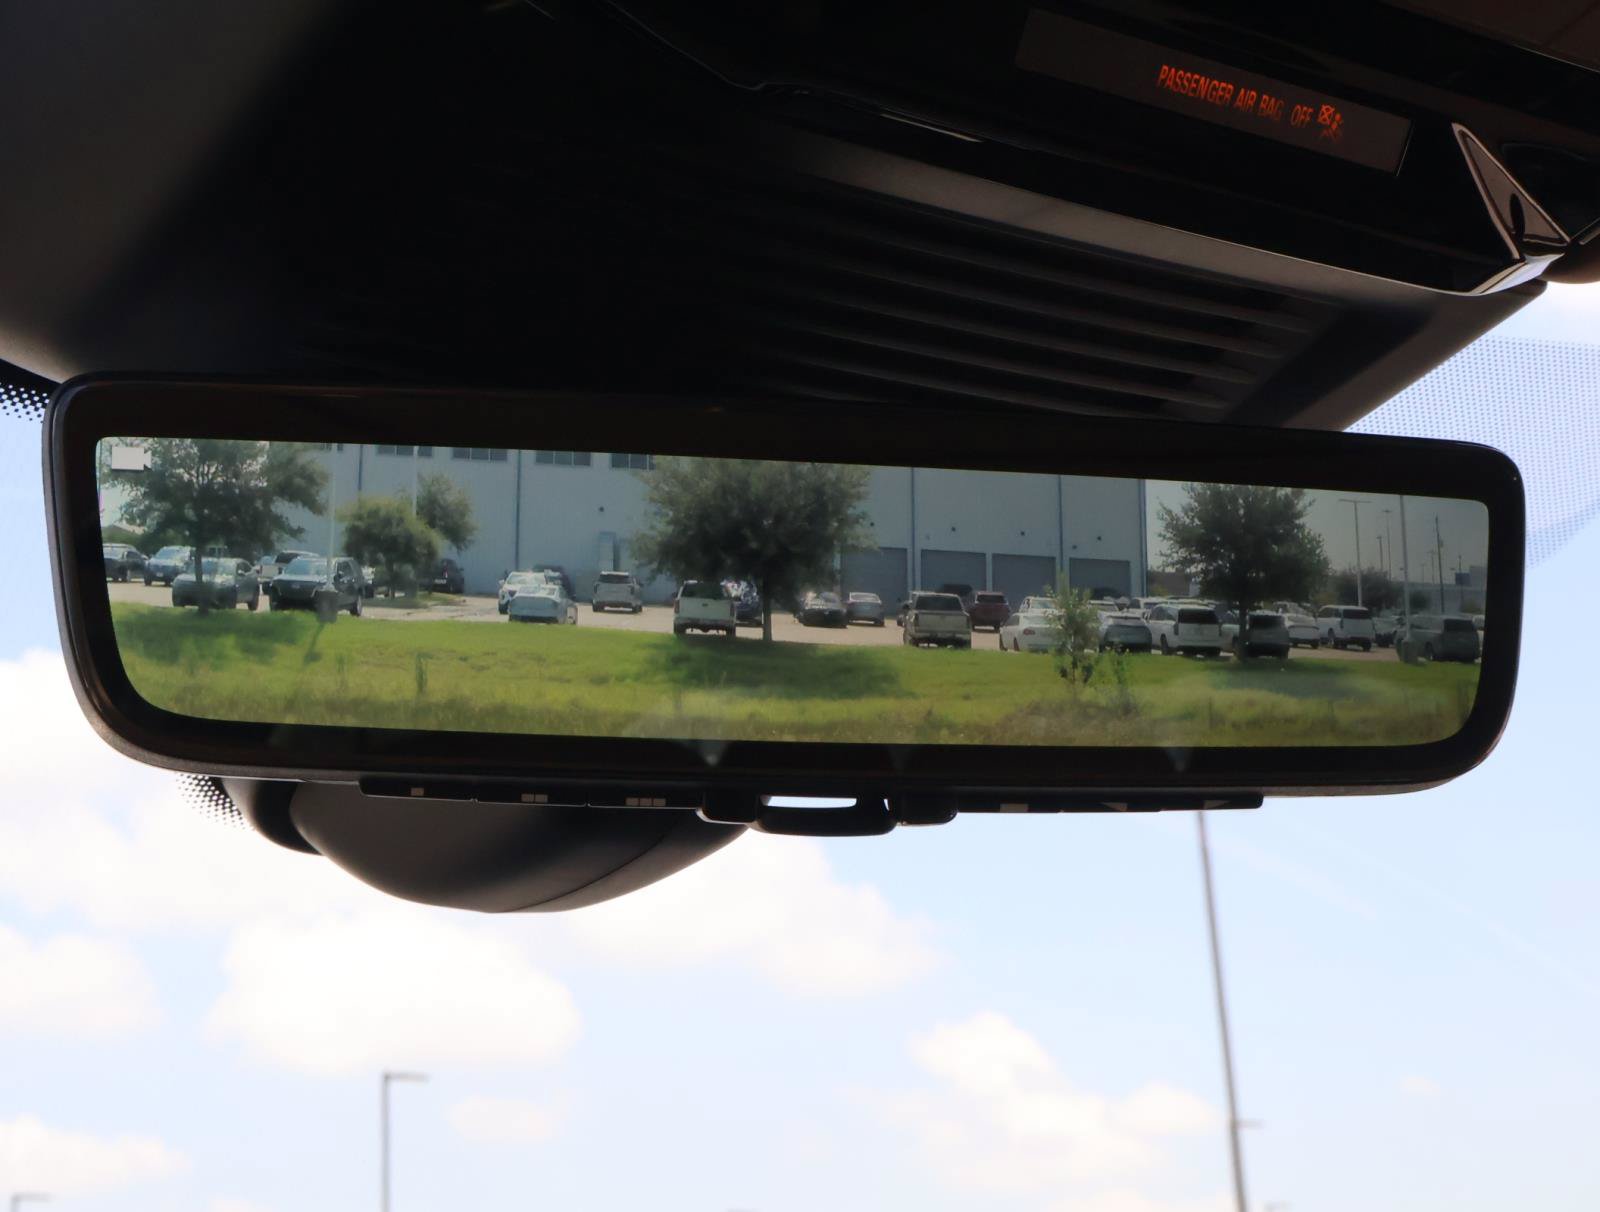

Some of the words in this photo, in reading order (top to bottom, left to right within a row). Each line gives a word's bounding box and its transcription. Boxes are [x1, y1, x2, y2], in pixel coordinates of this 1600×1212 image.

[1157, 64, 1234, 105] PASSENGER
[1234, 87, 1257, 113] AIR
[1258, 94, 1285, 122] BAG
[1290, 104, 1315, 129] OFF
